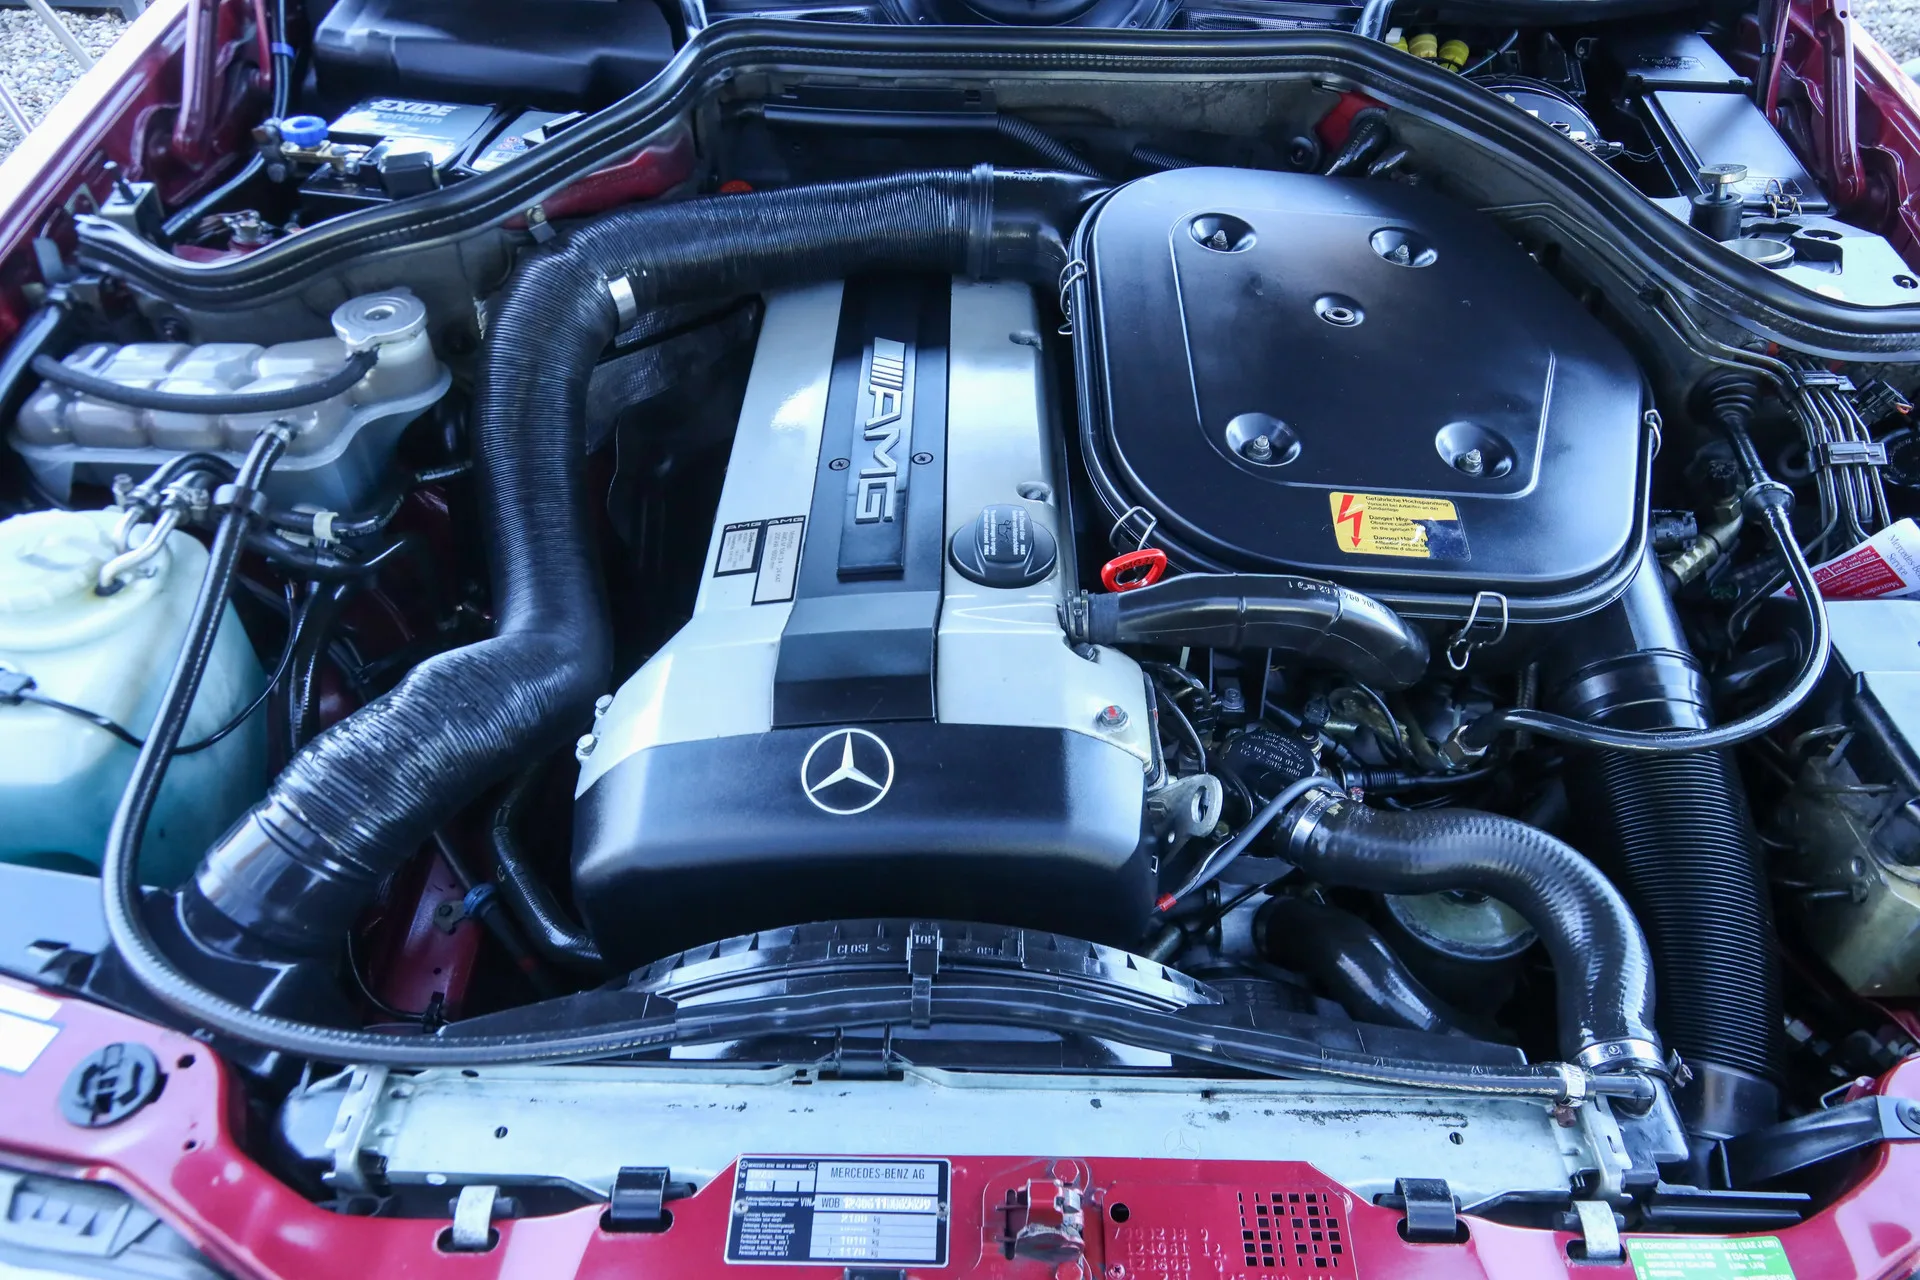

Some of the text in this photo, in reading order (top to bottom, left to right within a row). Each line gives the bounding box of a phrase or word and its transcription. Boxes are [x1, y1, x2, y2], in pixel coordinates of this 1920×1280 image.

[371, 99, 458, 117] EXIDE
[855, 383, 904, 525] AMG
[726, 521, 762, 530] AMG
[768, 517, 804, 525] AMG
[1886, 552, 1908, 576] Service
[914, 934, 936, 945] TOP
[830, 1167, 925, 1180] MERCEDES-BENZ AG
[821, 1197, 840, 1208] WDB
